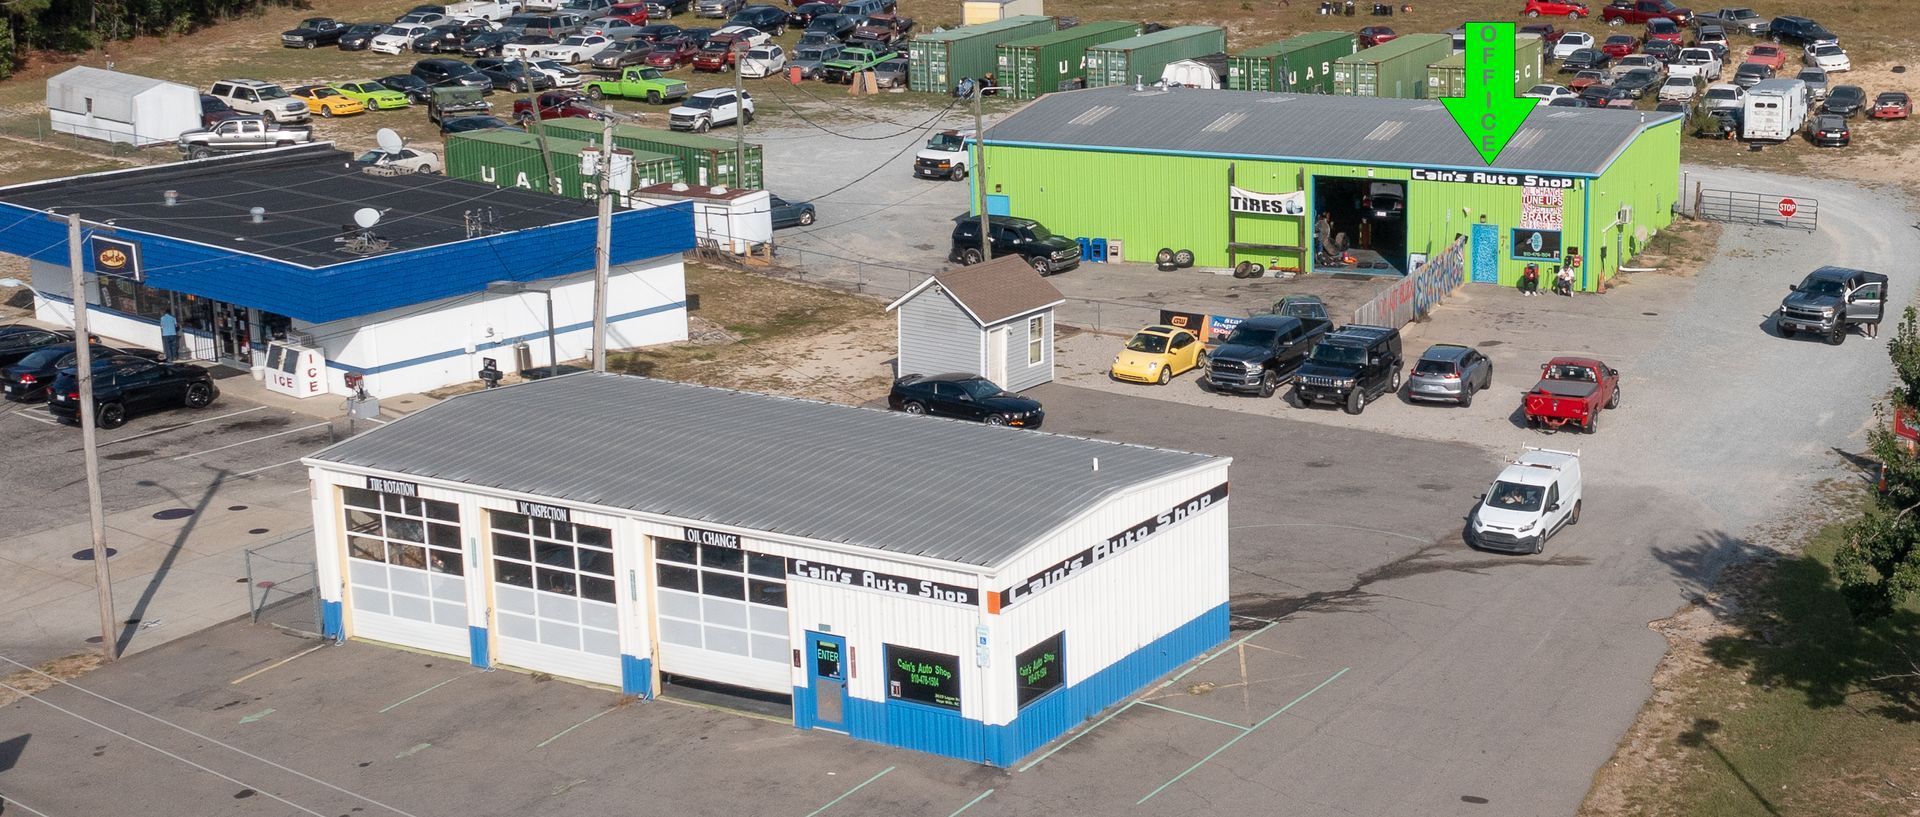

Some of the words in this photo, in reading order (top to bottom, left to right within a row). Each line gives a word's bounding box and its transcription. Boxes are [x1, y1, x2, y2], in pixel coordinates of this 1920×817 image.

[1412, 168, 1467, 182] Cain's
[1472, 172, 1518, 186] Auto
[1523, 175, 1573, 188] Shop
[1522, 195, 1544, 205] TUNE
[1546, 196, 1563, 206] UPS
[1535, 187, 1563, 197] CHANGE
[1231, 196, 1283, 213] TIRES
[1779, 203, 1796, 212] STOP
[1522, 212, 1562, 223] BRAKES
[273, 374, 294, 389] ICE
[308, 354, 319, 393] ICE
[370, 478, 383, 492] TIRE
[383, 480, 415, 497] ROTATION
[520, 501, 530, 515] NC
[530, 503, 567, 522] INSPECTION
[687, 529, 701, 543] OIL
[702, 531, 737, 549] CHANGE
[1008, 556, 1084, 605] Cain's
[1092, 526, 1148, 566] Auto
[1155, 493, 1211, 533] Shop
[795, 559, 852, 585] Cain's
[863, 571, 908, 594] Auto
[919, 581, 968, 604] Shop
[817, 648, 839, 662] ENTER
[1044, 653, 1055, 663] Shop
[897, 658, 915, 673] Cain's
[918, 663, 933, 674] Auto
[935, 665, 951, 679] Shop
